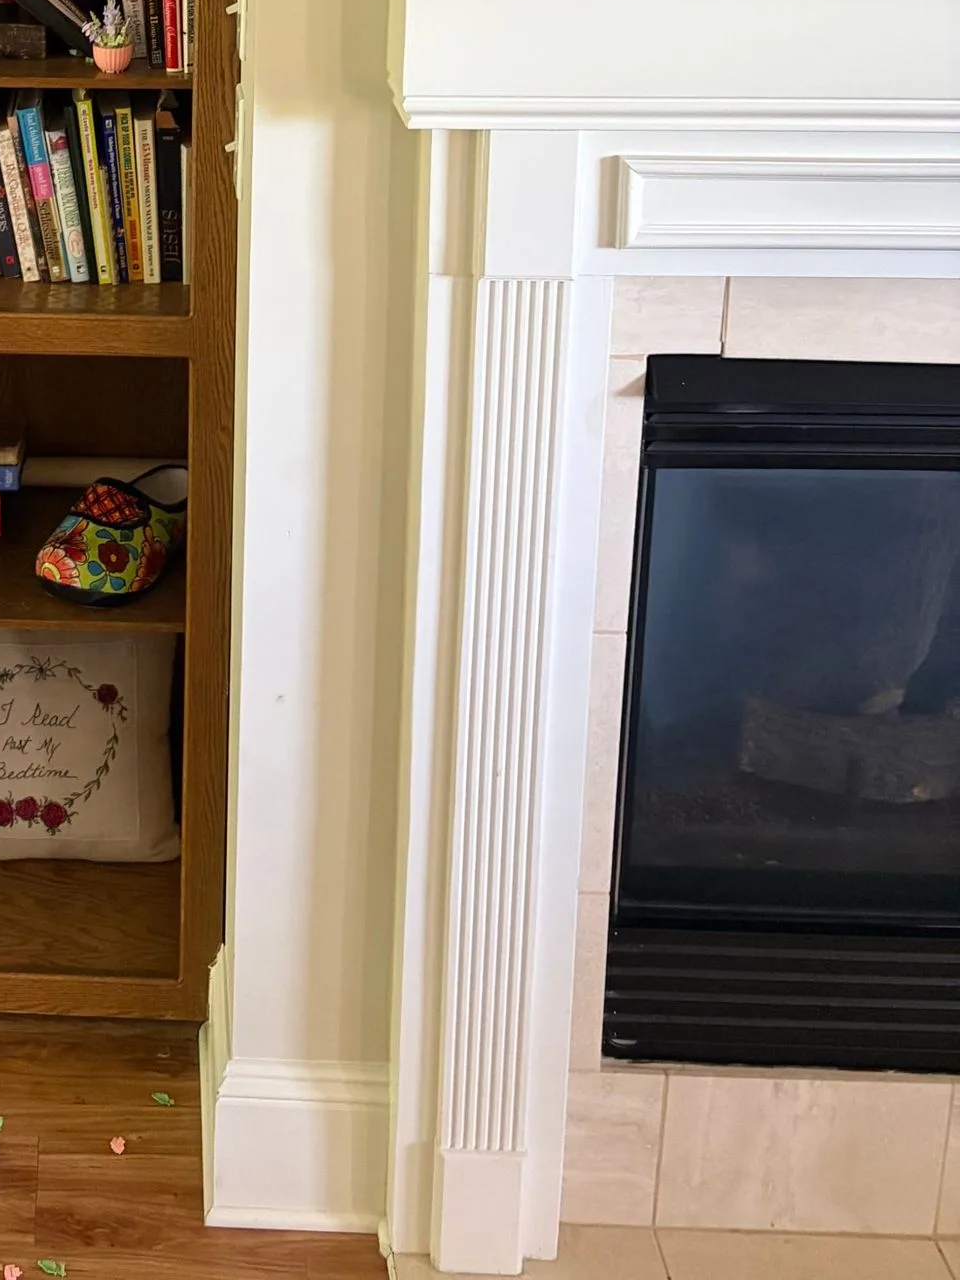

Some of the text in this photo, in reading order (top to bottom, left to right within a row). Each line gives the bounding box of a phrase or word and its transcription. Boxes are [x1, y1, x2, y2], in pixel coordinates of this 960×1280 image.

[120, 112, 129, 125] PACK
[28, 125, 42, 161] childhood
[142, 151, 153, 183] Minute
[145, 185, 153, 209] MONEY
[40, 200, 54, 260] Schlessinger
[146, 209, 154, 241] MANAGER
[163, 209, 180, 263] JESUS
[21, 703, 80, 729] Read
[2, 736, 62, 761] Past My
